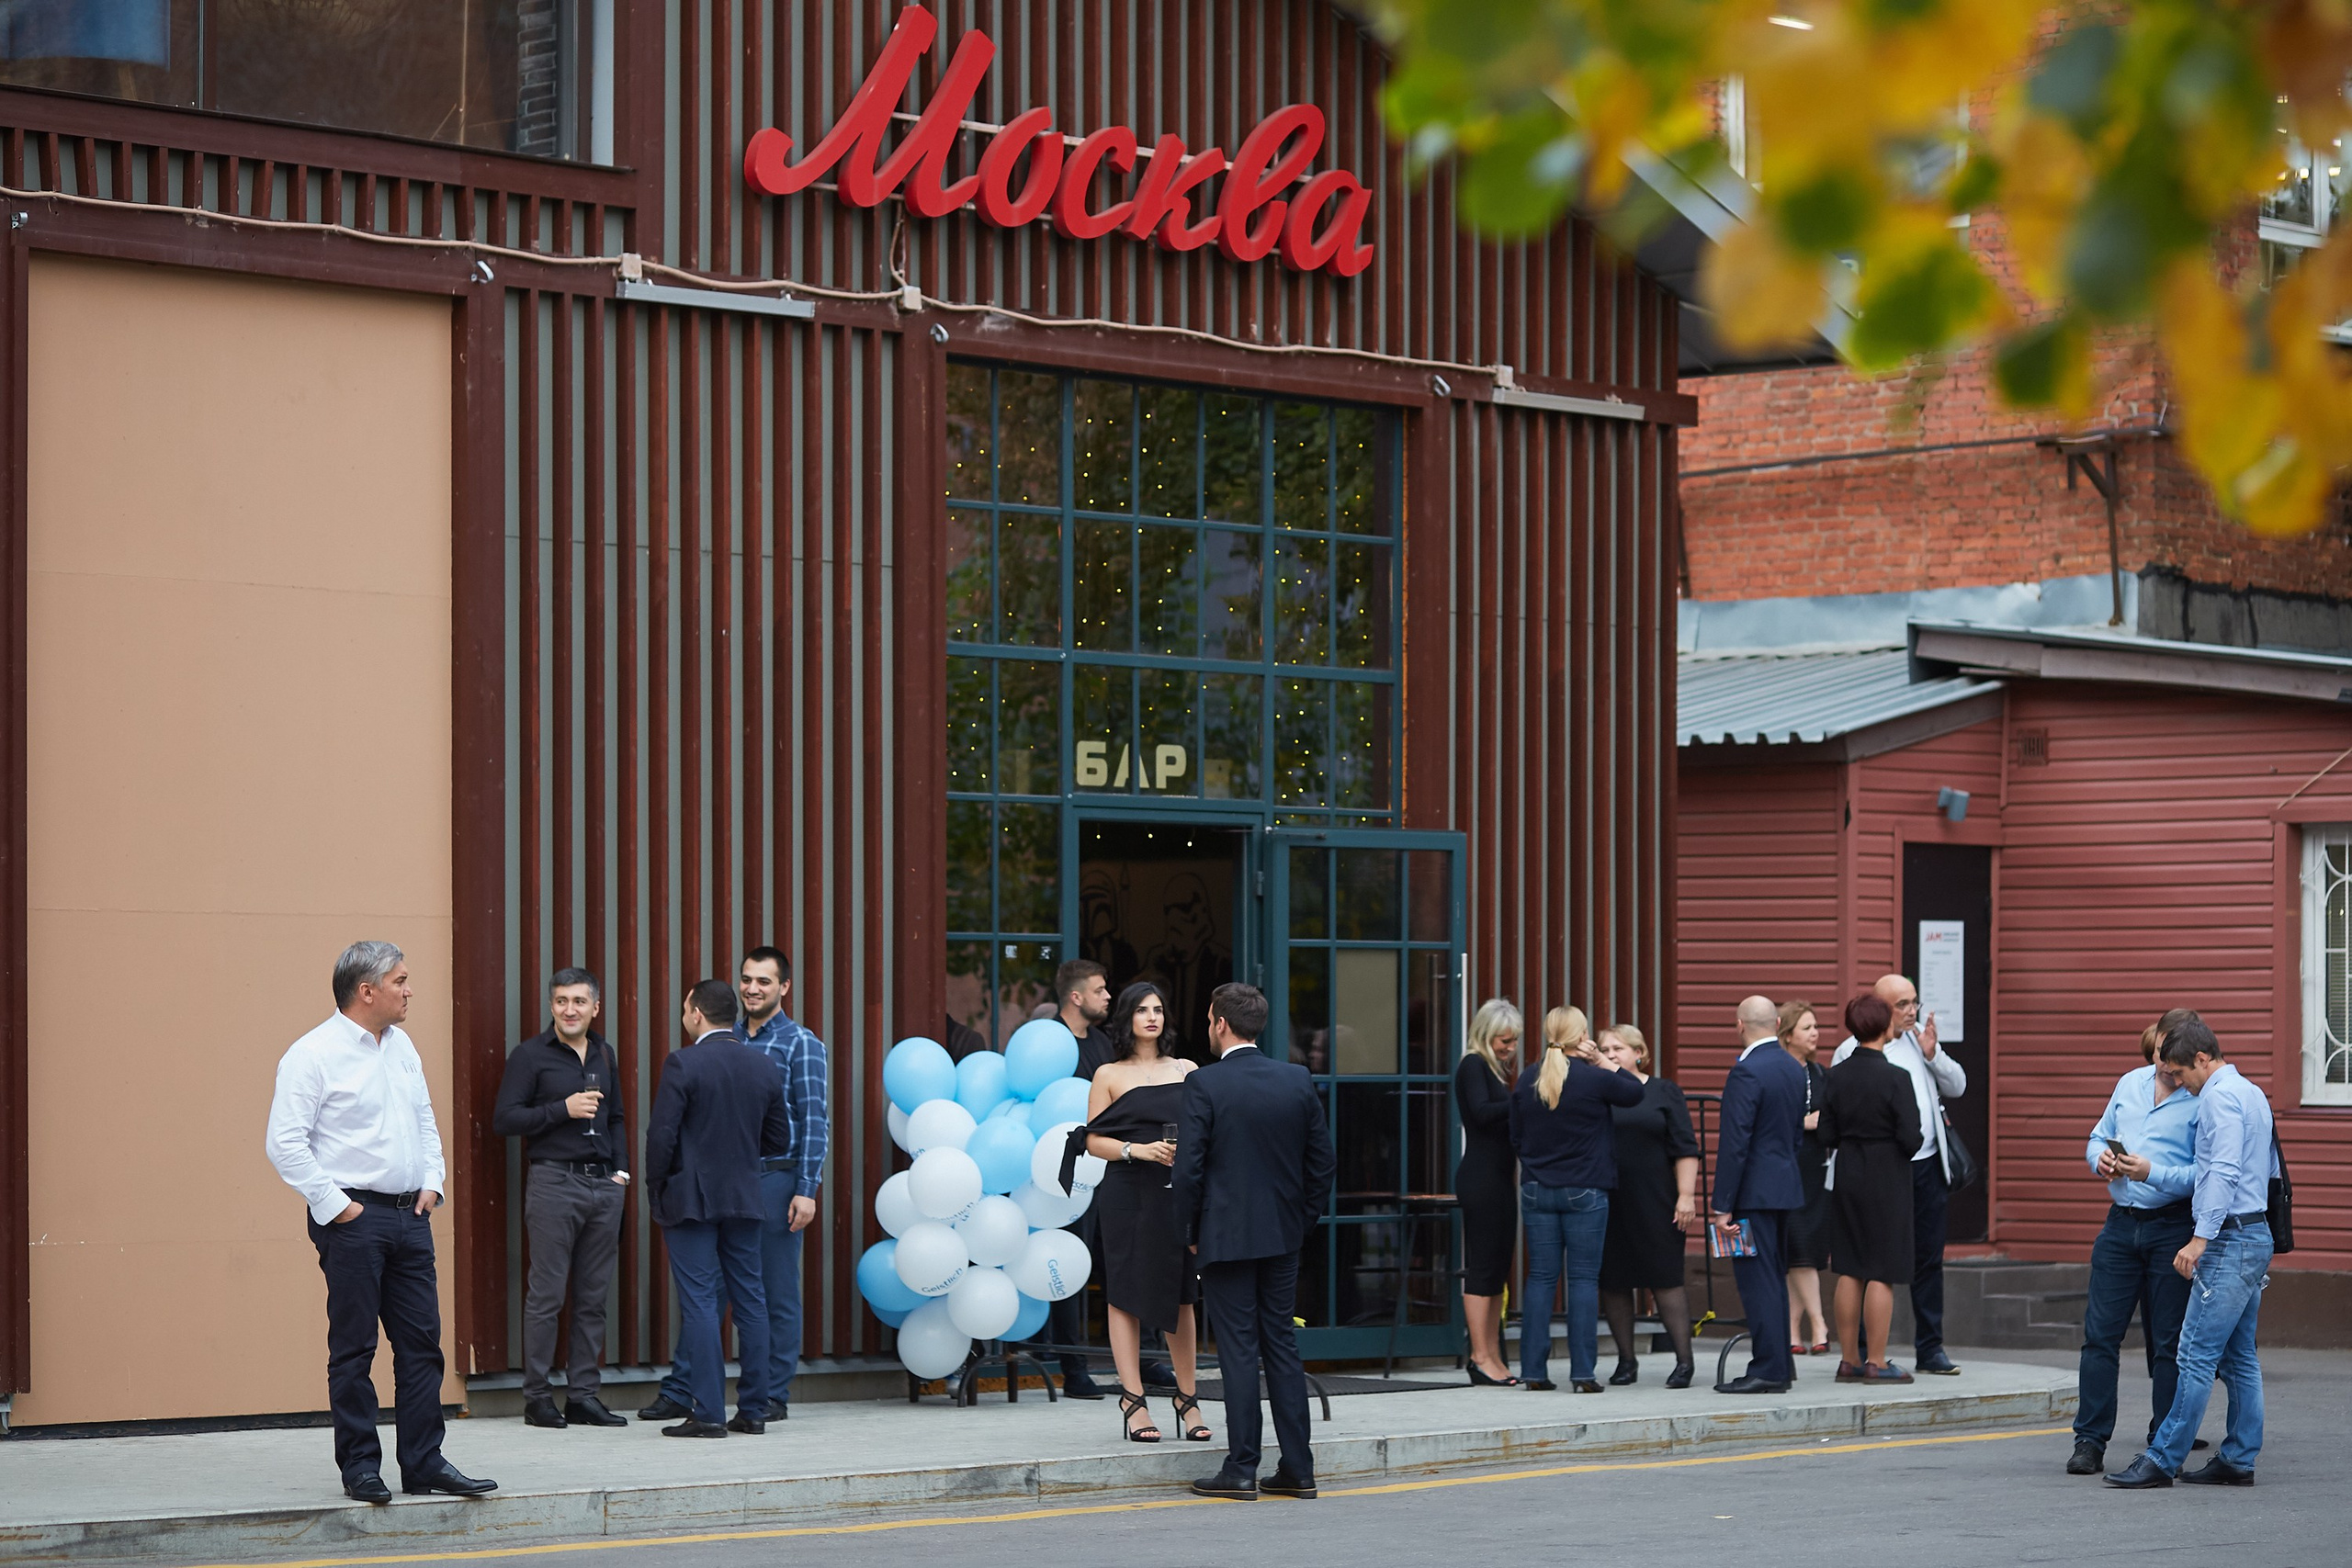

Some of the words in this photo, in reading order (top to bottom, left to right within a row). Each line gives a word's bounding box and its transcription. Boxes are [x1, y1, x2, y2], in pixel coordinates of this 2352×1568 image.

[744, 5, 1374, 277] Москва
[1076, 740, 1187, 789] БАР
[922, 1268, 963, 1293] Geistlich
[1047, 1258, 1068, 1298] Geistlich
